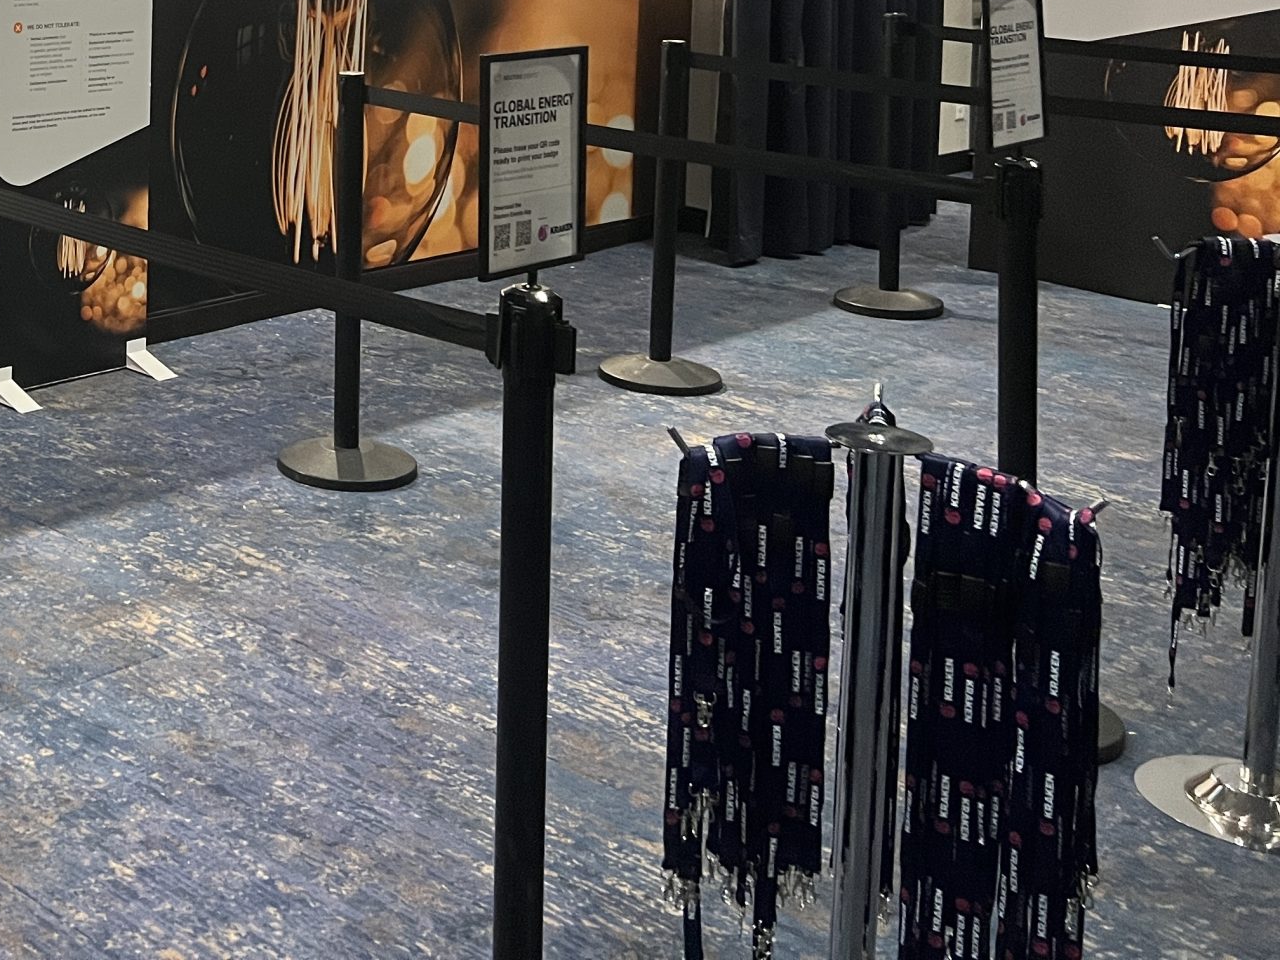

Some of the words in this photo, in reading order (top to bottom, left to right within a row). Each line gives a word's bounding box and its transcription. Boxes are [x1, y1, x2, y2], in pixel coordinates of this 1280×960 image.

[494, 98, 536, 114] GLOBAL
[538, 92, 575, 109] ENERGY
[494, 110, 557, 130] TRANSITION
[705, 444, 719, 467] KRA
[703, 480, 712, 516] KRAK
[950, 462, 966, 509] KRAKEN
[973, 484, 988, 531] KRAKEN
[921, 489, 933, 535] KRAKEN
[989, 491, 1001, 538] KRAKEN
[758, 524, 768, 568] KRAKEN
[1029, 533, 1045, 581] KRAKEN
[744, 575, 753, 618] KRAKEN
[816, 559, 826, 602] KRAKEN
[773, 611, 783, 654] KRAKEN
[674, 654, 682, 697] KRAKEN
[792, 650, 801, 693] KRAKEN
[943, 657, 955, 702] KRAKEN
[1048, 650, 1060, 698] KRAKEN
[815, 673, 824, 716] KRAKEN
[910, 675, 920, 721] KRAKEN
[963, 679, 975, 724] KRAKEN
[682, 727, 691, 768] KRAKEN
[772, 724, 781, 767] KRAKEN
[1015, 727, 1025, 774] KRAKEN
[669, 768, 678, 809] KRAKEN
[726, 780, 734, 821] KRAKEN
[786, 761, 797, 803] KRAKEN
[939, 773, 951, 819] KRAKEN
[1043, 772, 1056, 820] KRAKEN
[810, 784, 820, 827] KRAKEN
[960, 796, 971, 842] KRAKEN
[1009, 847, 1019, 894] KRAKEN
[932, 887, 944, 933] KRAKEN
[998, 873, 1008, 920] KRAKEN
[1036, 893, 1048, 939] KRAKEN
[955, 913, 966, 959] KRAKEN
[971, 915, 981, 960] KRAKEN
